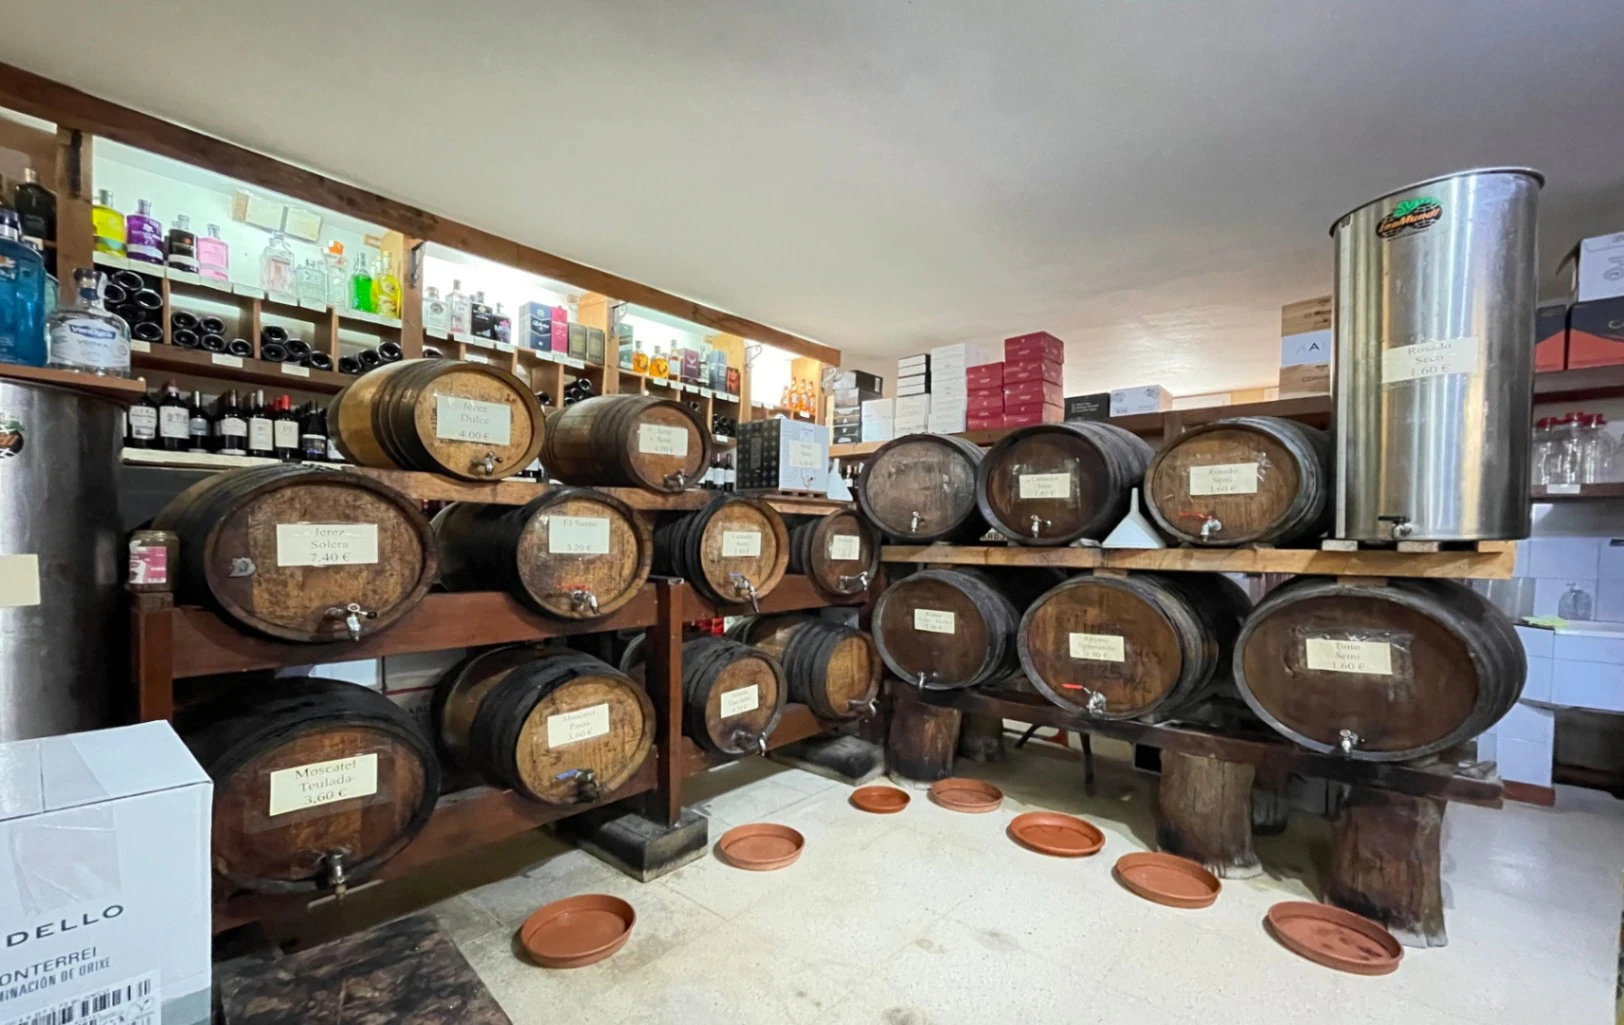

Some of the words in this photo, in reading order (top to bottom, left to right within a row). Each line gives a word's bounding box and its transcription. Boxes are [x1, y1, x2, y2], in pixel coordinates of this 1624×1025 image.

[1408, 343, 1452, 355] Rosado
[1414, 355, 1444, 365] Seco
[1411, 366, 1438, 377] 1.60
[1441, 364, 1450, 373] €
[462, 401, 488, 413] Jerez
[460, 413, 490, 425] Dulce
[458, 430, 481, 441] 4.00
[483, 432, 490, 441] €
[1208, 467, 1238, 476] Rosado
[1212, 477, 1232, 485] Semi
[1209, 485, 1228, 493] 1.60
[314, 527, 345, 537] Jerez
[310, 539, 350, 549] Solera
[310, 552, 339, 563] 7.40
[342, 552, 351, 562] €
[1336, 642, 1361, 651] Tinto
[1335, 652, 1360, 661] Semi
[1332, 662, 1355, 670] 1.60
[1358, 663, 1366, 671] €
[295, 759, 356, 780] Moscatel
[299, 774, 353, 792] Teulada
[304, 789, 334, 805] 3.60
[338, 787, 347, 798] €
[6, 904, 125, 947] DELLO
[61, 969, 74, 983] DE
[79, 957, 112, 977] ORIXE
